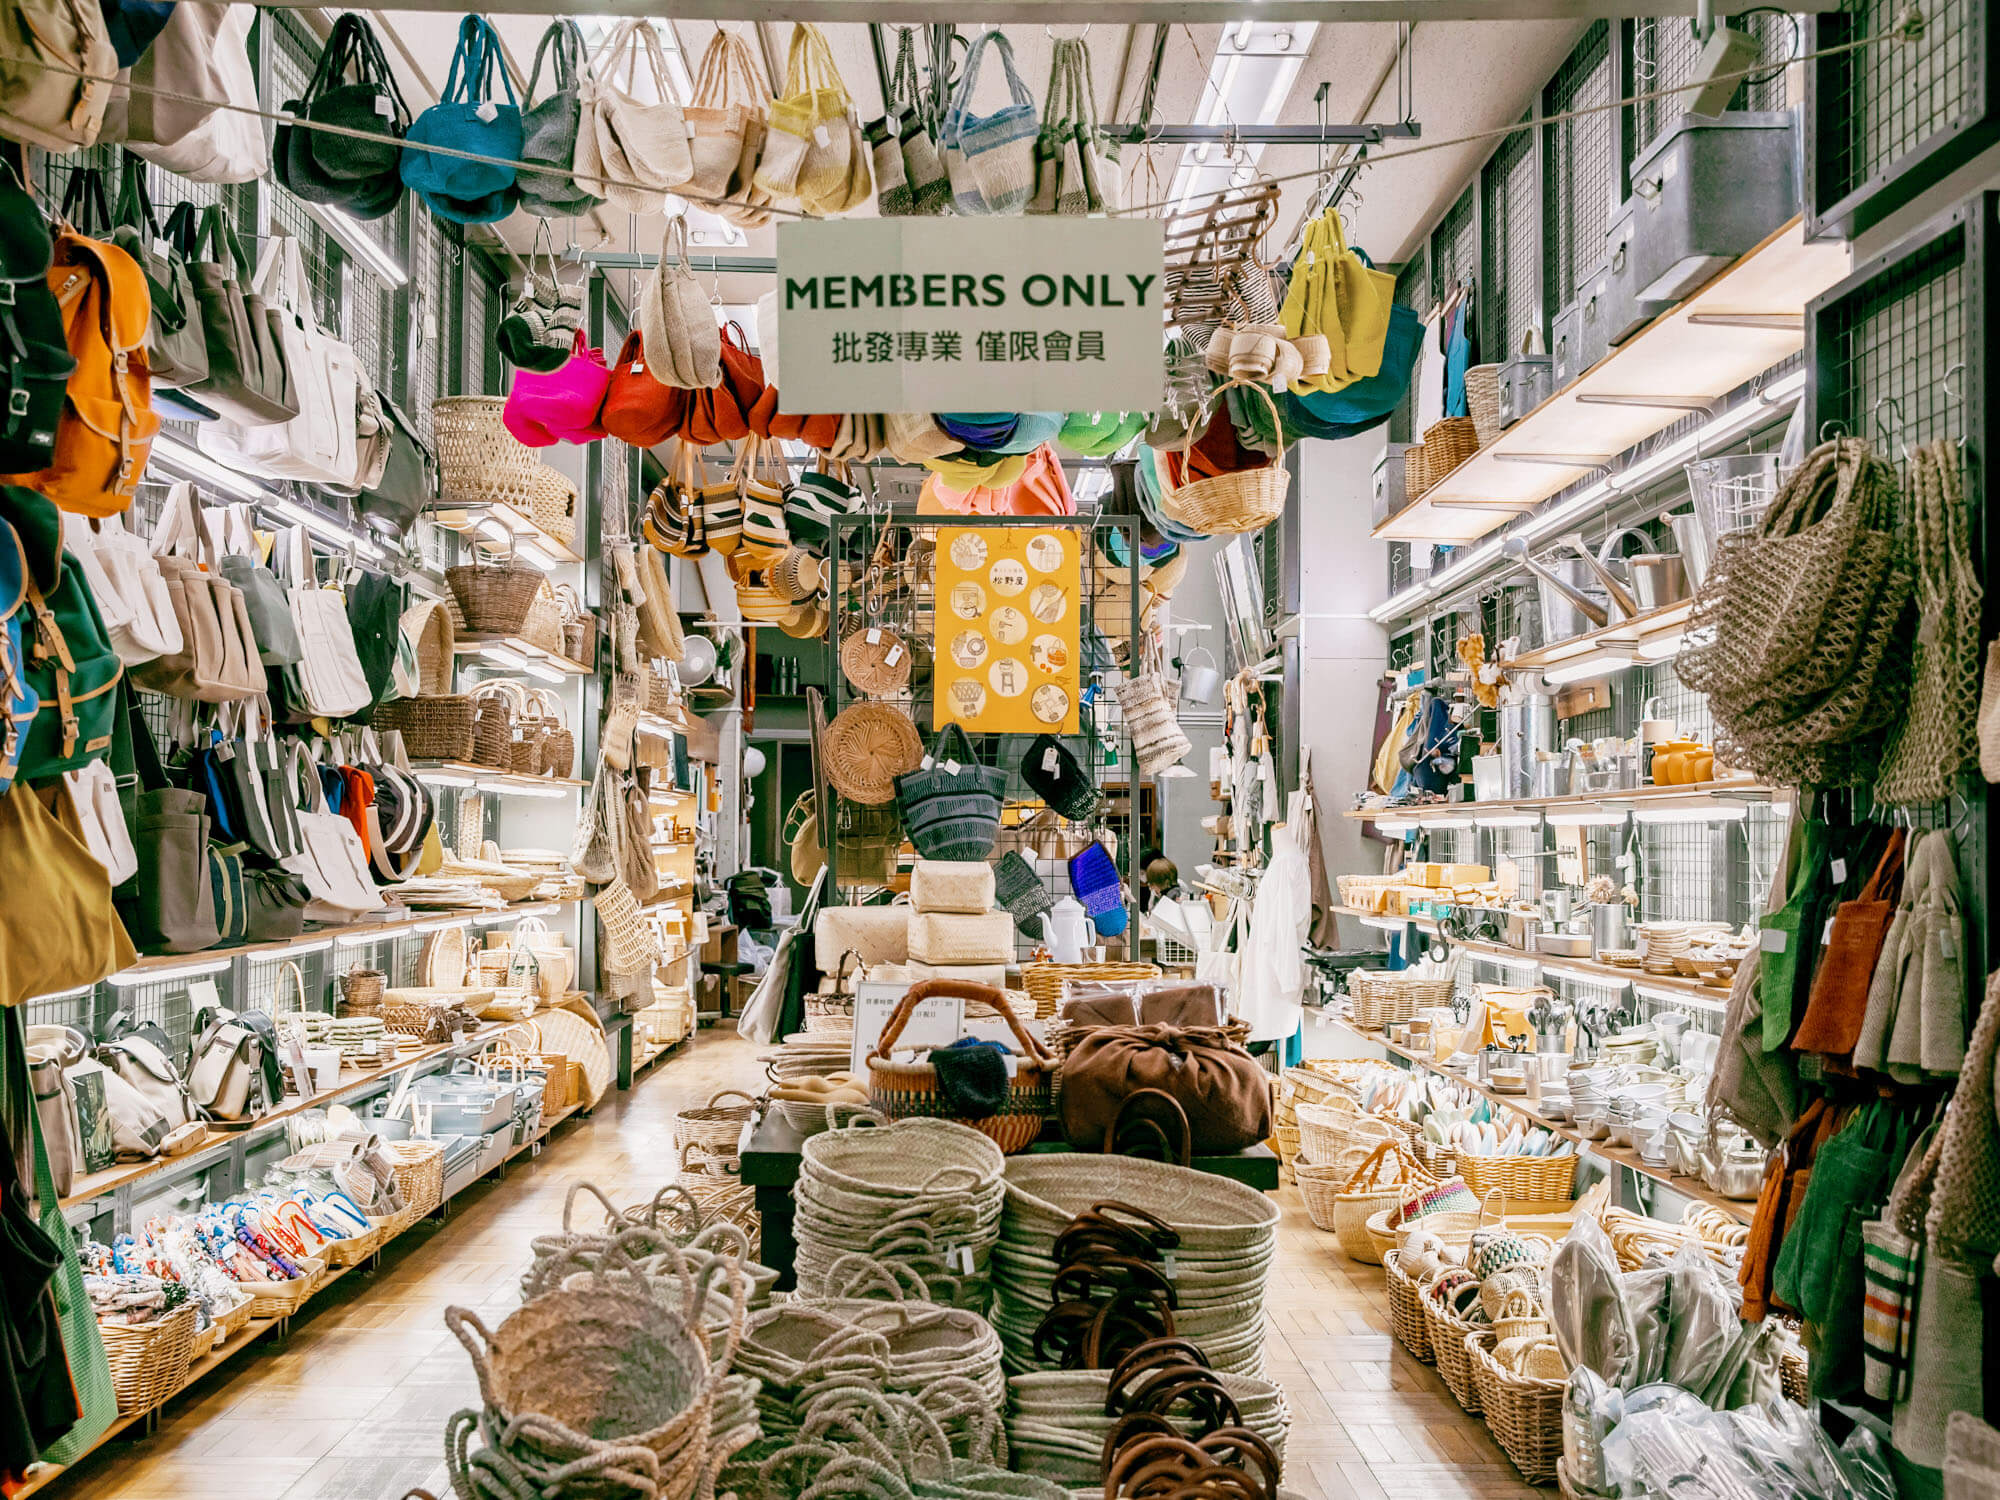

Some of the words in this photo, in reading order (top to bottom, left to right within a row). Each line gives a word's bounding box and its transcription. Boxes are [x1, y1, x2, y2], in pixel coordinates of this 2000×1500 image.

[785, 275, 1006, 310] MEMBERS
[1021, 274, 1157, 307] ONLY
[832, 331, 962, 363] 批發專業
[976, 331, 1106, 361] 僅限會員
